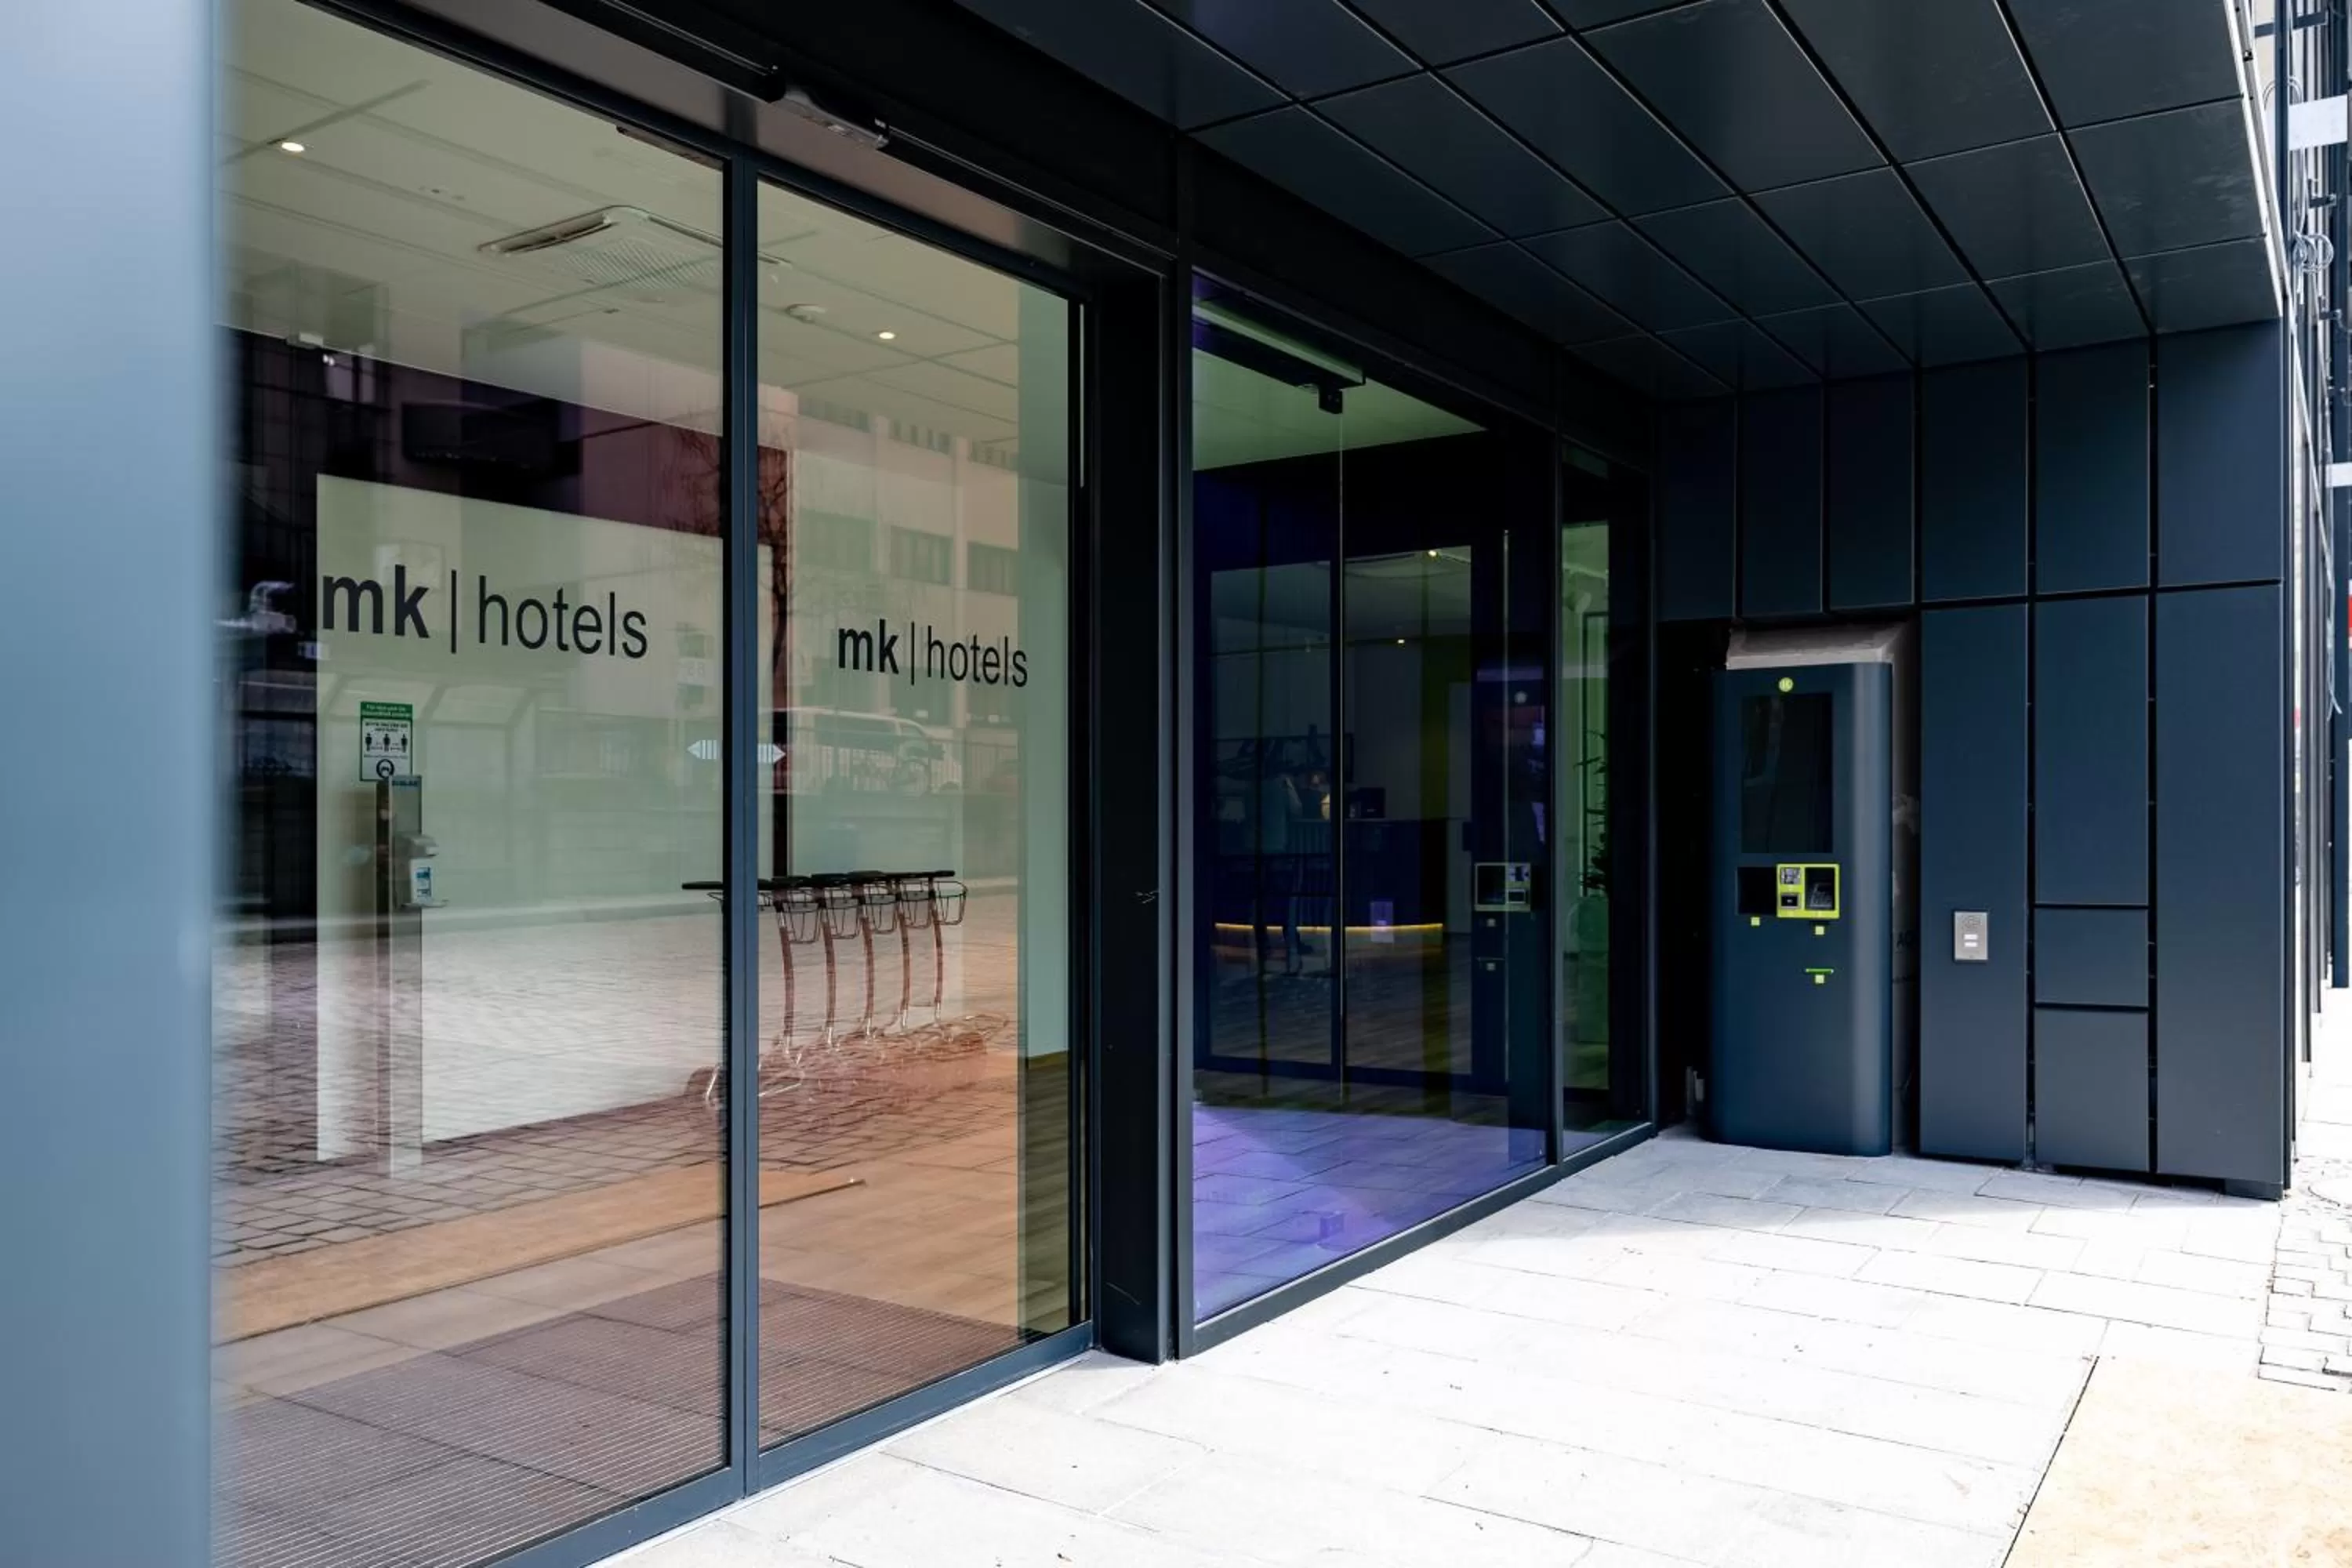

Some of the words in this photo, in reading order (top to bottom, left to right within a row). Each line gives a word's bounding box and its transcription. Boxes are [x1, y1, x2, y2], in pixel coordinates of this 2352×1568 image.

[322, 564, 430, 639] mk
[479, 575, 648, 659] hotels
[838, 619, 899, 674] mk
[927, 625, 1028, 688] hotels
